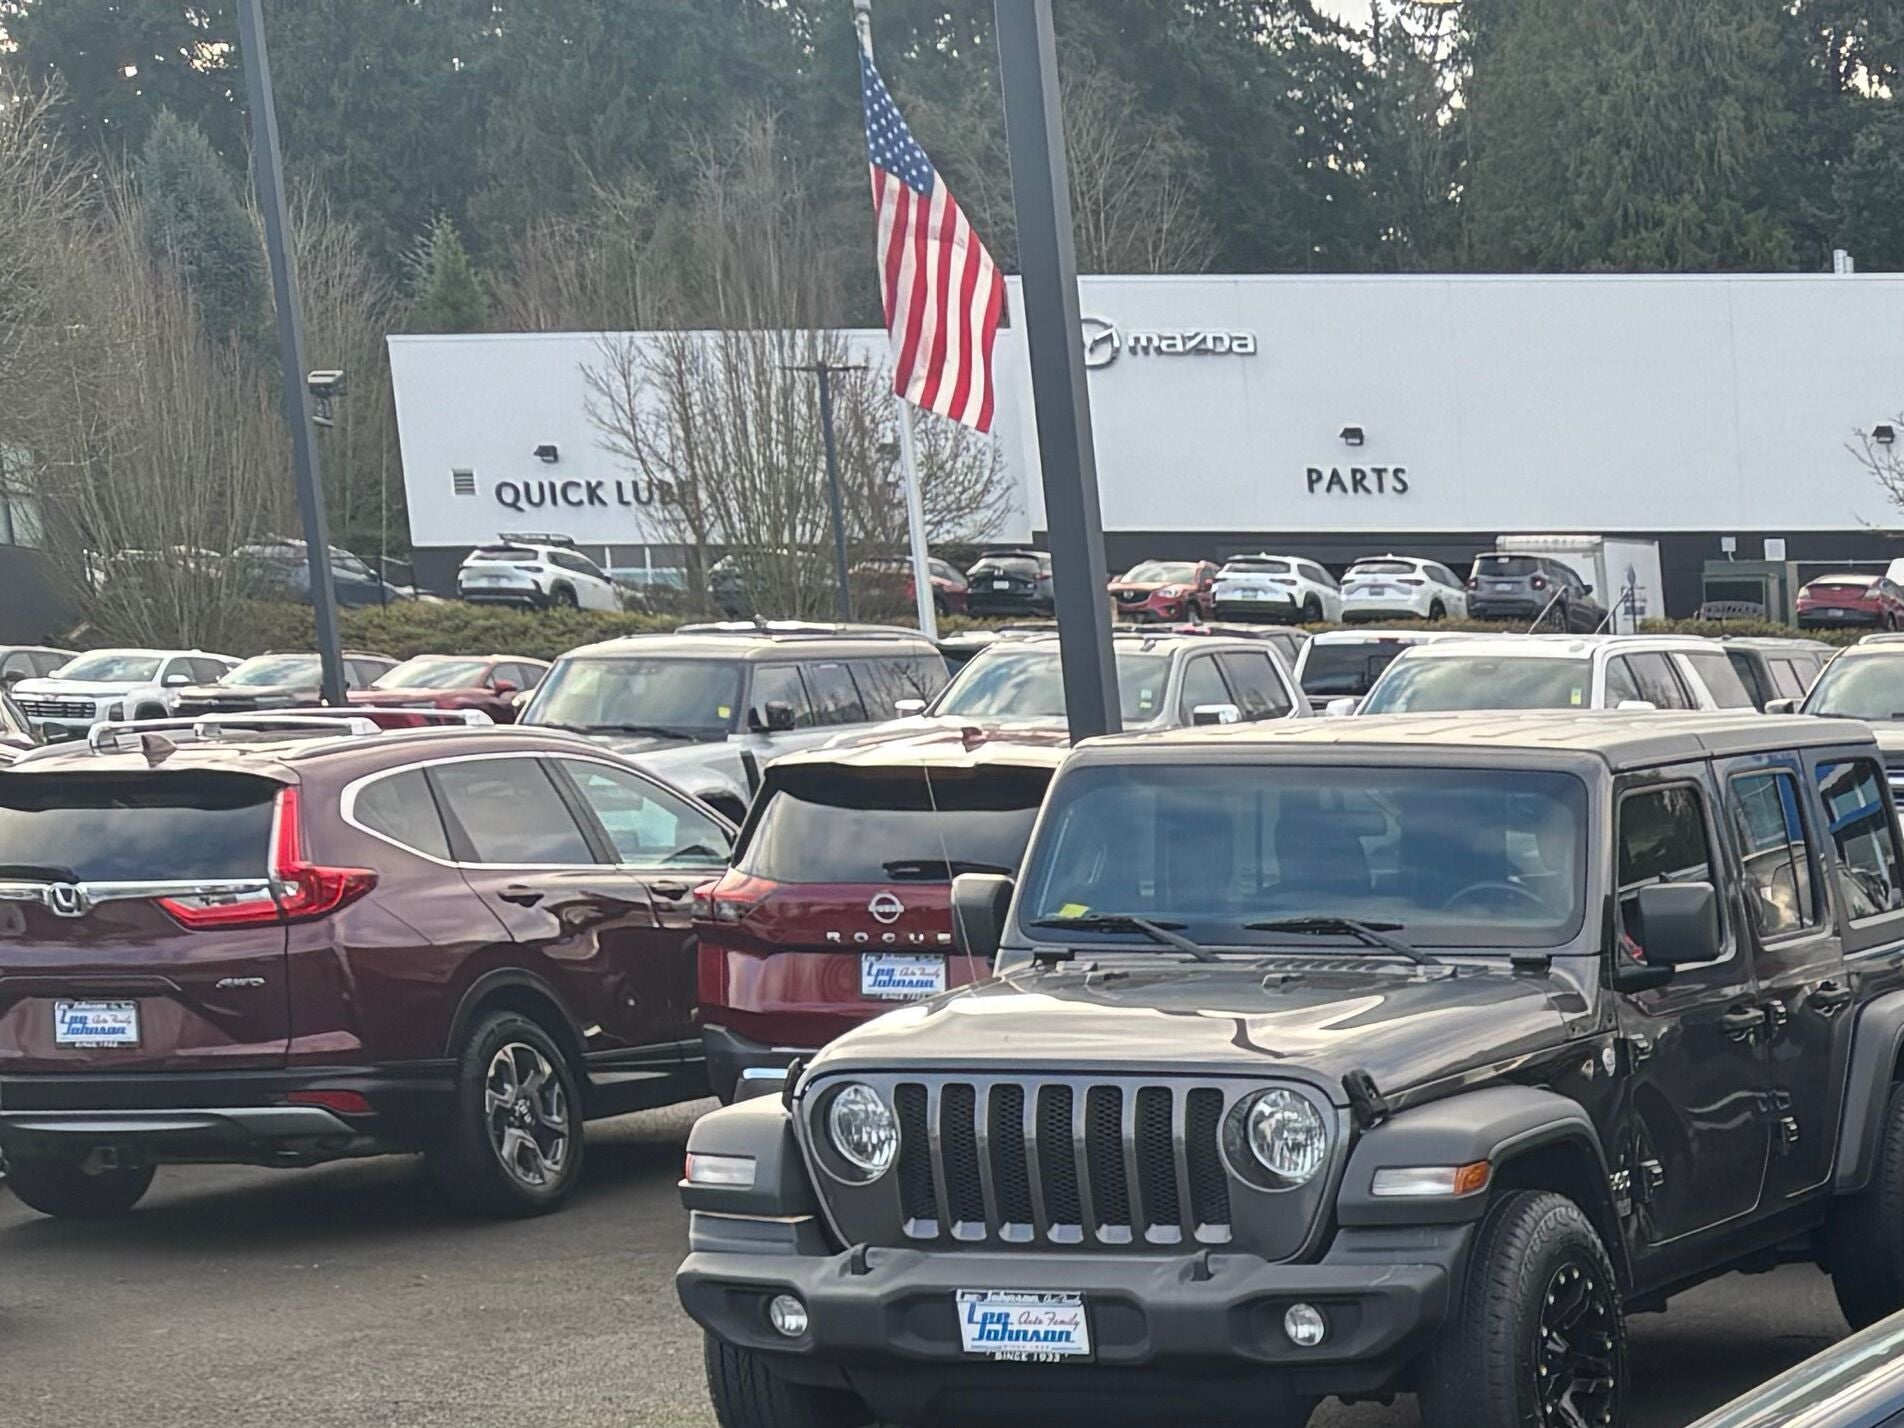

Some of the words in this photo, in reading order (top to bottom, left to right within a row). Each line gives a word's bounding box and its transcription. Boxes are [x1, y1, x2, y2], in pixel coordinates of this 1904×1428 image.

[1127, 331, 1257, 356] mazda
[1305, 466, 1410, 495] PARTS
[495, 480, 608, 512] QUICK
[968, 1302, 1014, 1325] Lee
[1018, 1311, 1044, 1326] Auto
[1044, 1311, 1080, 1332] Family
[971, 1321, 1075, 1342] Johnson
